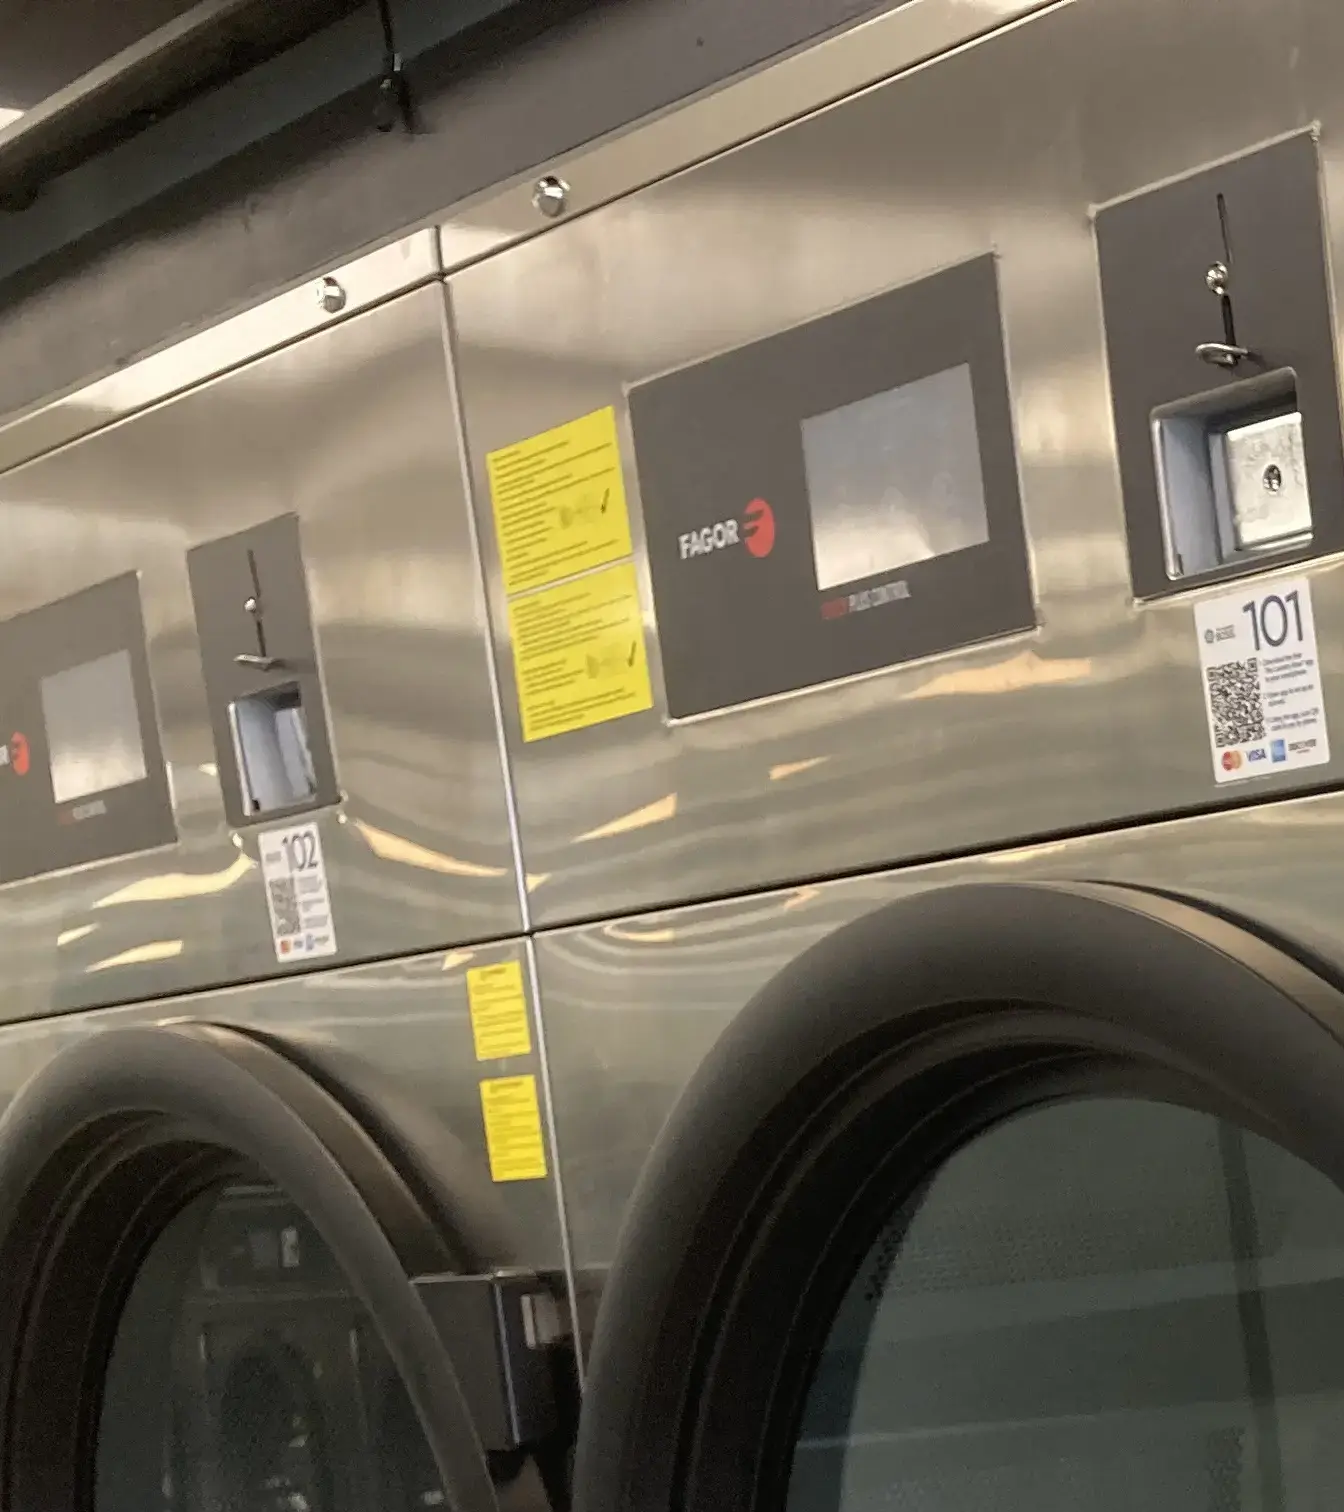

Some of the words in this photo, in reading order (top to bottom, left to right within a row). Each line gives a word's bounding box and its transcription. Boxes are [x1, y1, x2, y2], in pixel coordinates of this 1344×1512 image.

[678, 519, 740, 559] FAGOR
[1243, 590, 1303, 651] 101
[282, 831, 318, 873] 102
